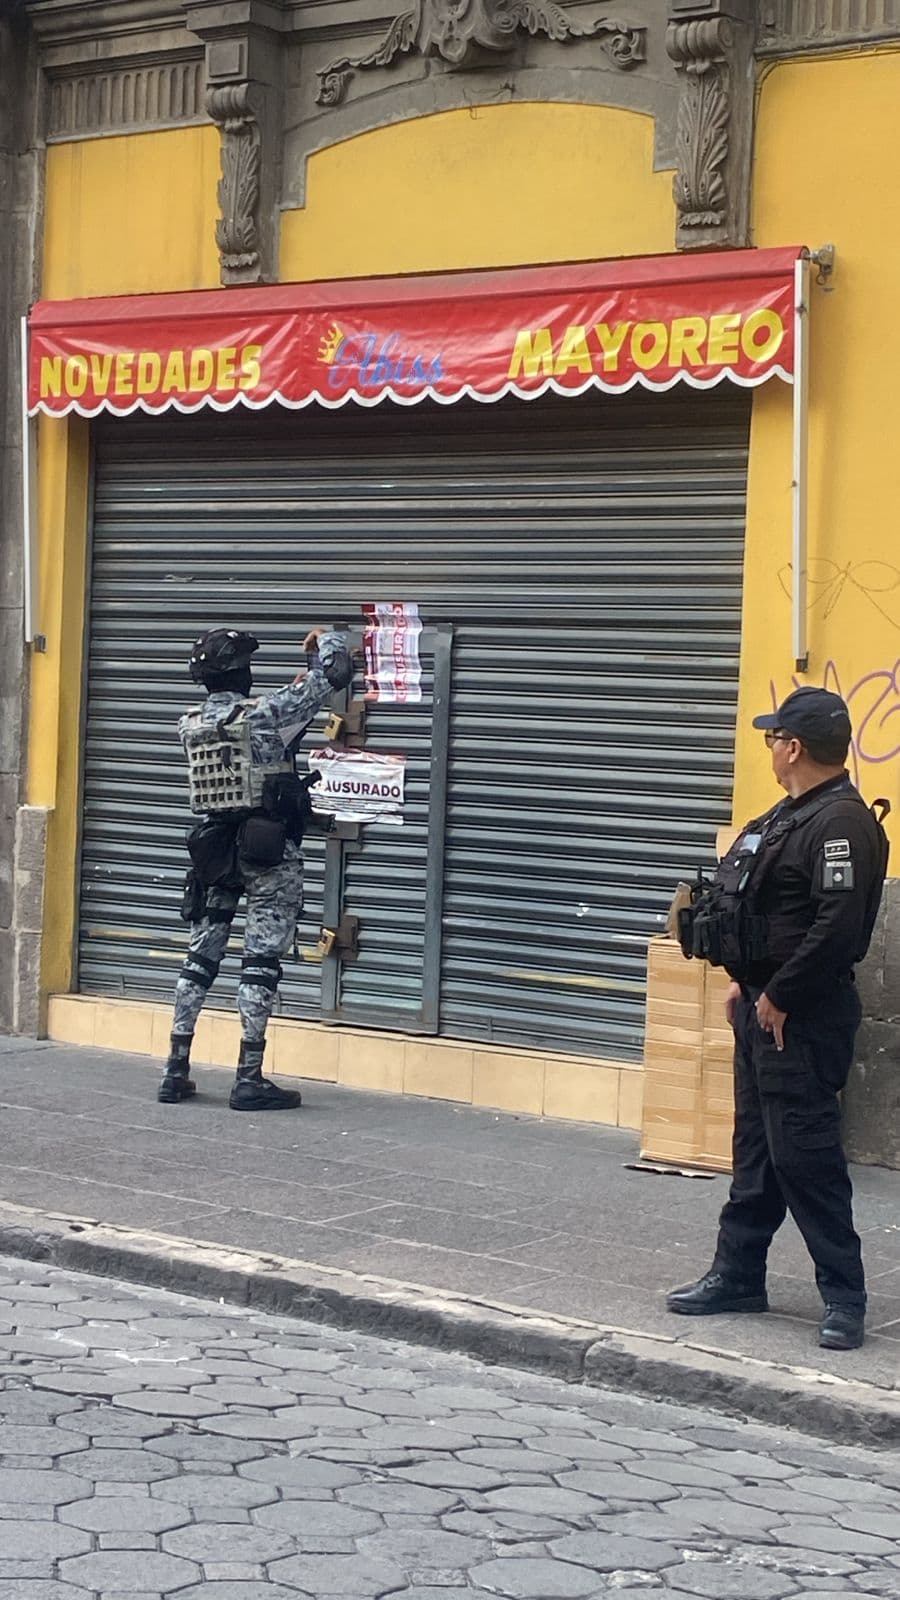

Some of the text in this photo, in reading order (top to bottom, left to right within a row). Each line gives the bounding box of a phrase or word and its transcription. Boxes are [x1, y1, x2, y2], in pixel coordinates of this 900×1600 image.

[39, 345, 263, 398] NOVEDADES
[328, 331, 444, 388] Abiss
[507, 308, 784, 380] MAYOREO
[313, 780, 401, 798] AUSURADO
